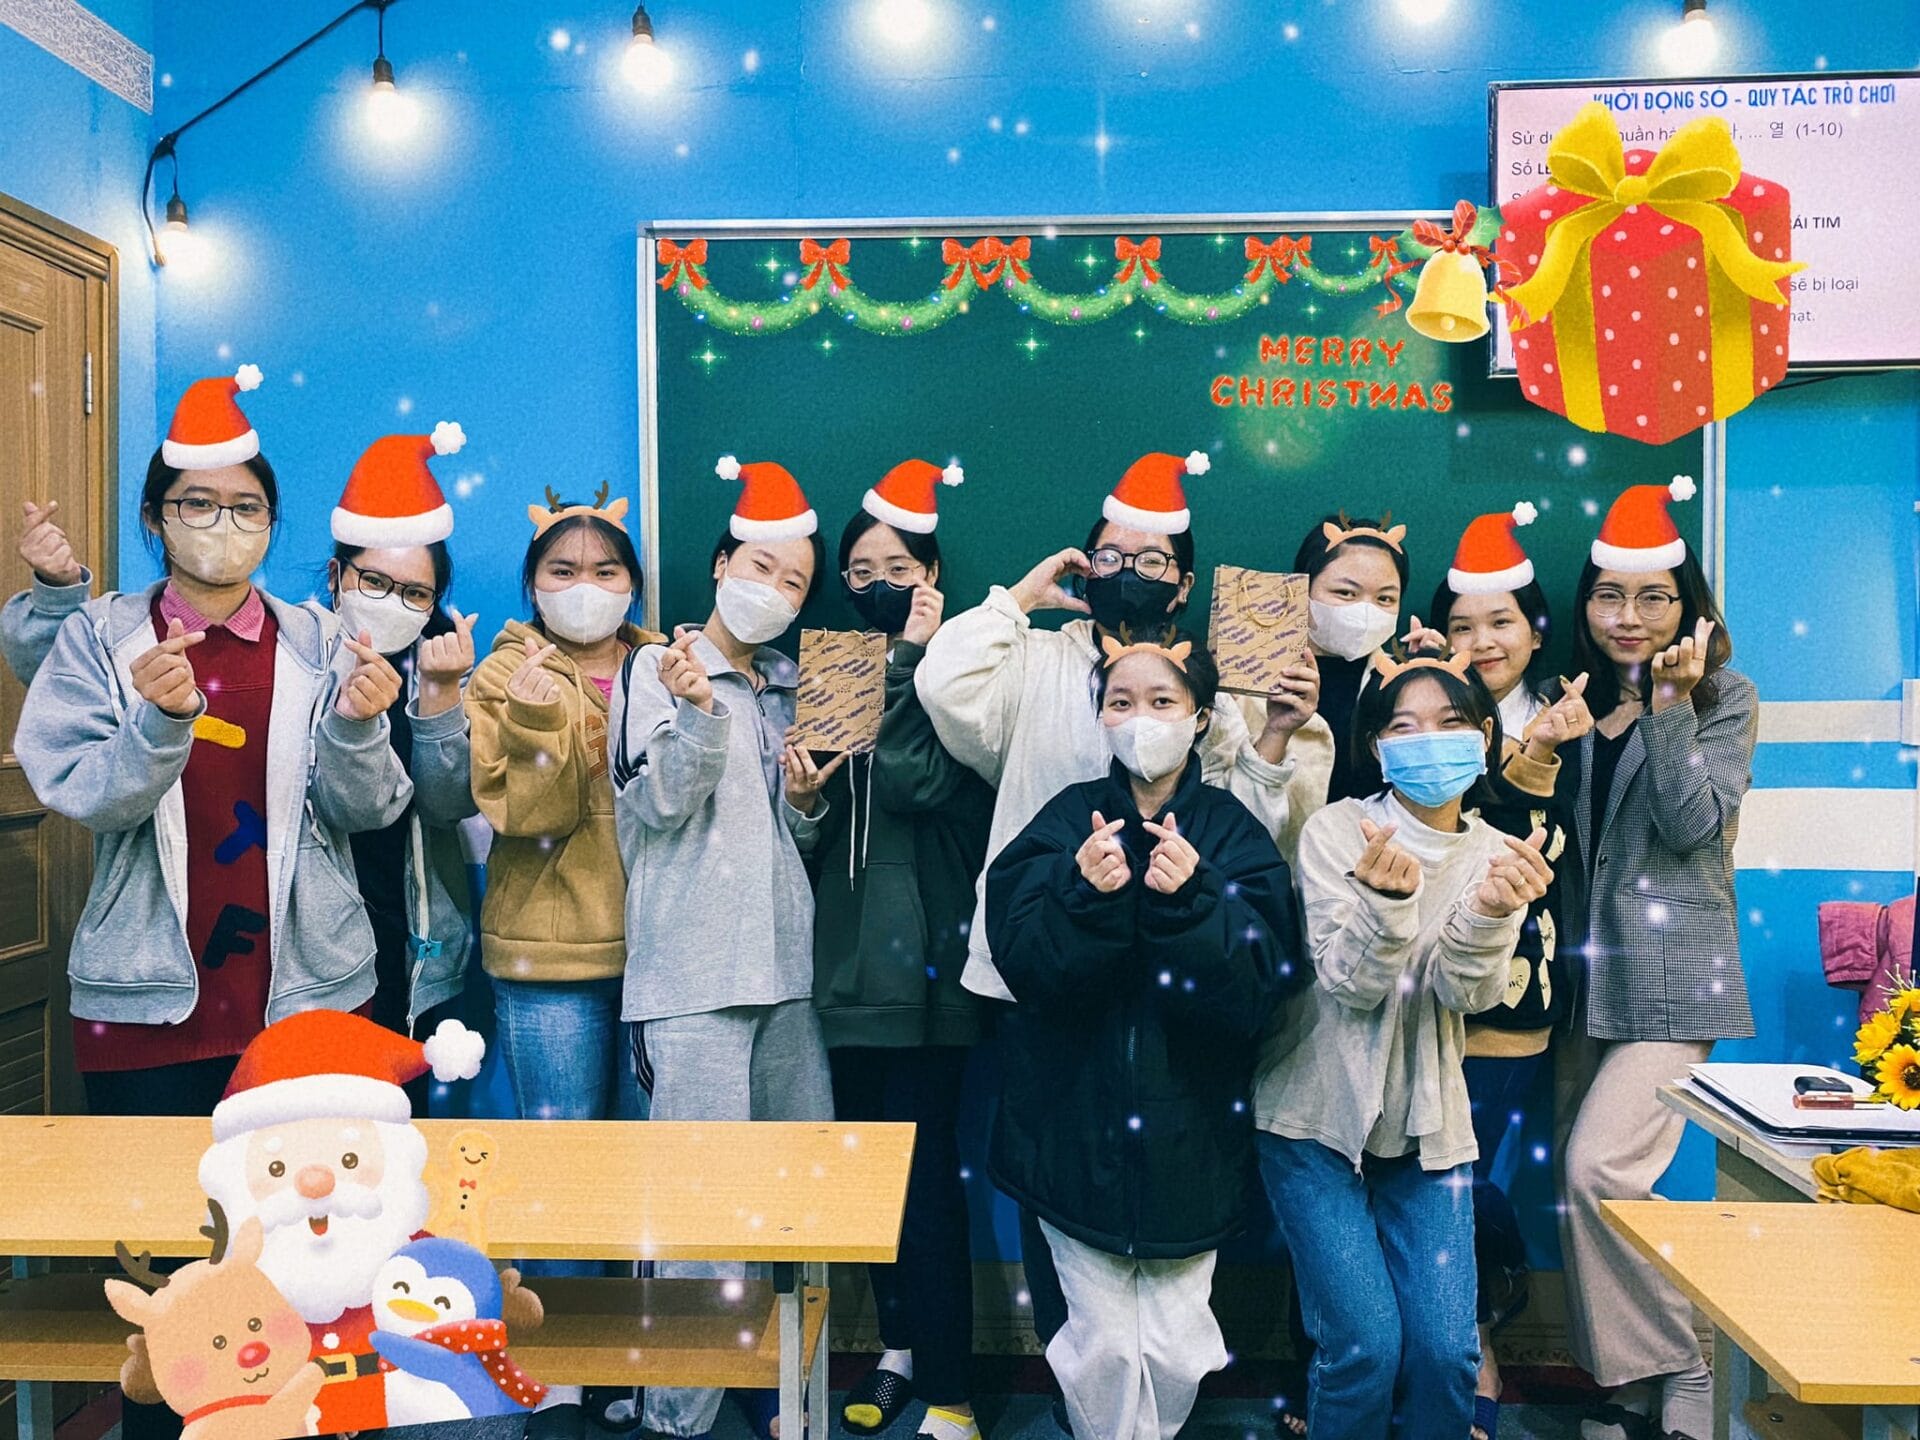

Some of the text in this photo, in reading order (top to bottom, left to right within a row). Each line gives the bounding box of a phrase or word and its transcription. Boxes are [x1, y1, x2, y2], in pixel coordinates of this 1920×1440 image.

[1748, 88, 1778, 107] QUY
[1823, 81, 1853, 105] TRÒ
[1859, 83, 1896, 104] CHƠI
[1769, 121, 1784, 139] 열
[1795, 121, 1844, 140] (1-10)
[1511, 158, 1533, 176] Số
[1812, 215, 1841, 229] TIM
[1812, 276, 1826, 294] bị
[1831, 276, 1859, 293] loại
